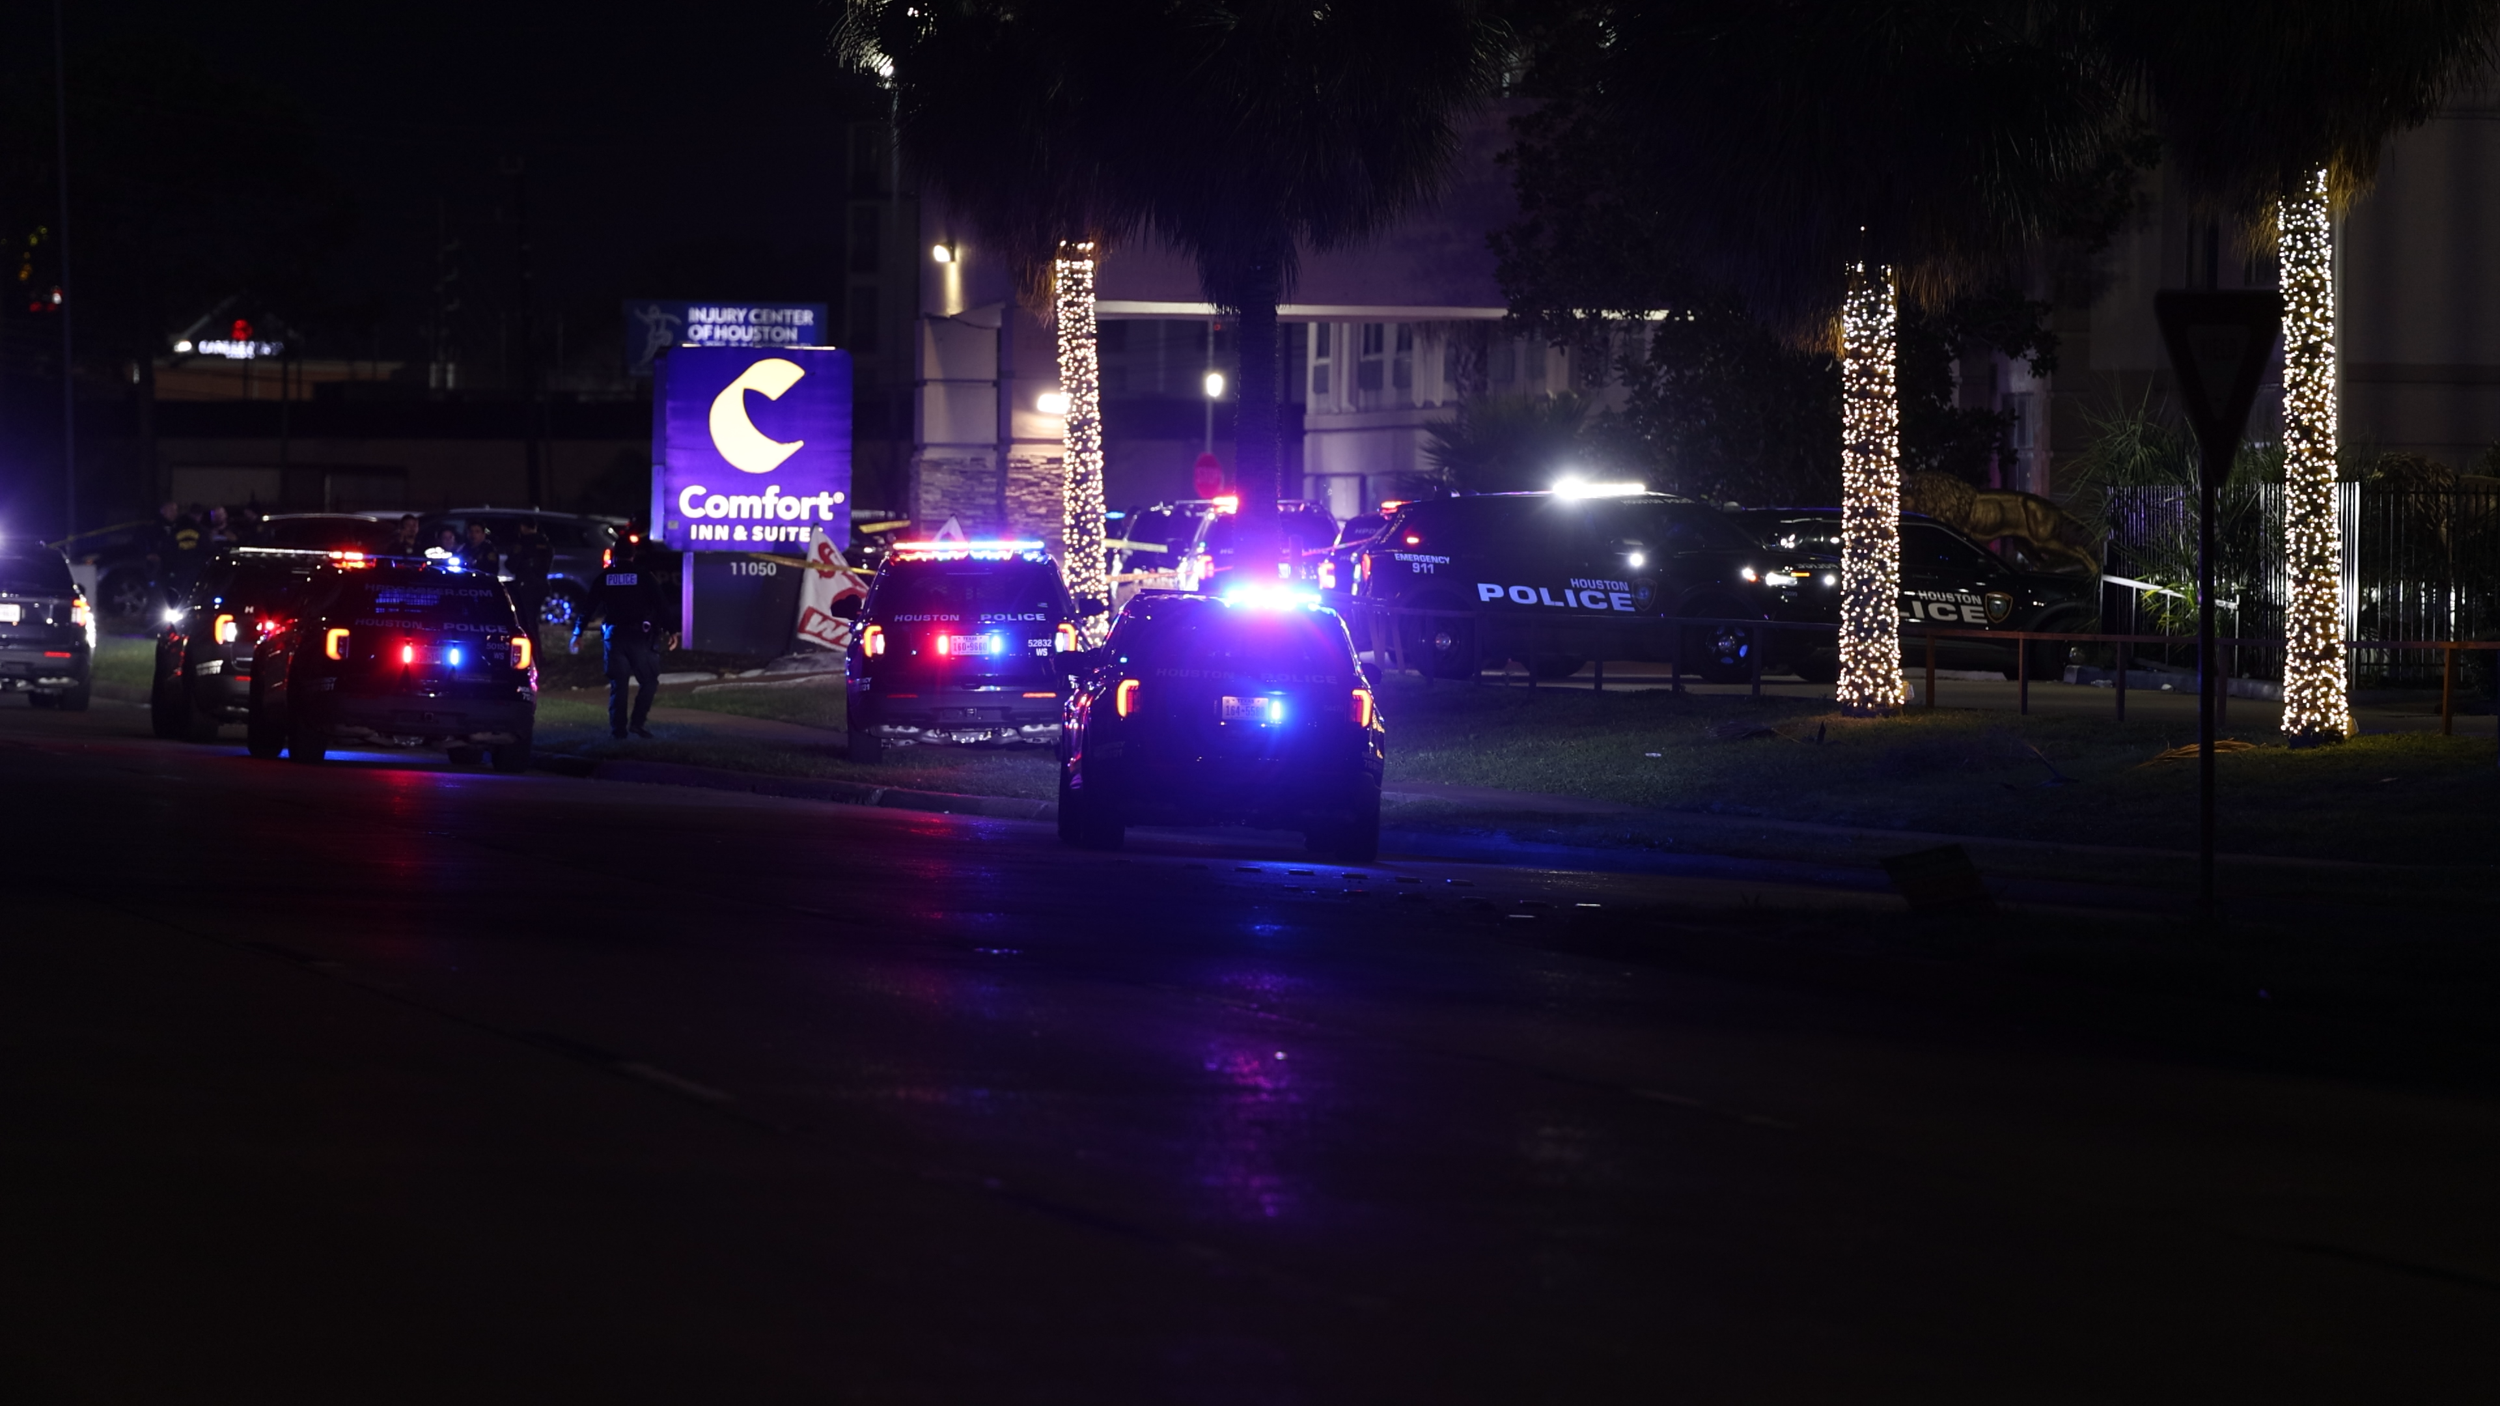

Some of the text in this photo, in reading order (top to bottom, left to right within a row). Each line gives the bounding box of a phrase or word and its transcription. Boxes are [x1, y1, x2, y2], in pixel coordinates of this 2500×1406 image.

[688, 306, 814, 325] INJURY CENTER
[687, 324, 798, 342] OF HOUSTON
[690, 525, 812, 542] INN & SUITE
[1394, 553, 1450, 564] EMERGENCY
[730, 562, 777, 576] 11050
[1412, 562, 1434, 574] 911
[608, 574, 635, 584] POLICE
[1570, 578, 1629, 591] HOUSTON
[1477, 583, 1636, 612] POLICE
[1917, 590, 1983, 605] HOUSTON
[894, 613, 1046, 622] HOUSTON POLICE
[355, 618, 509, 633] HOUSTON POLICE
[1028, 639, 1052, 647] 52832
[494, 652, 504, 660] WS
[1036, 648, 1048, 656] WS
[1155, 668, 1338, 684] HOUSTON POLICE
